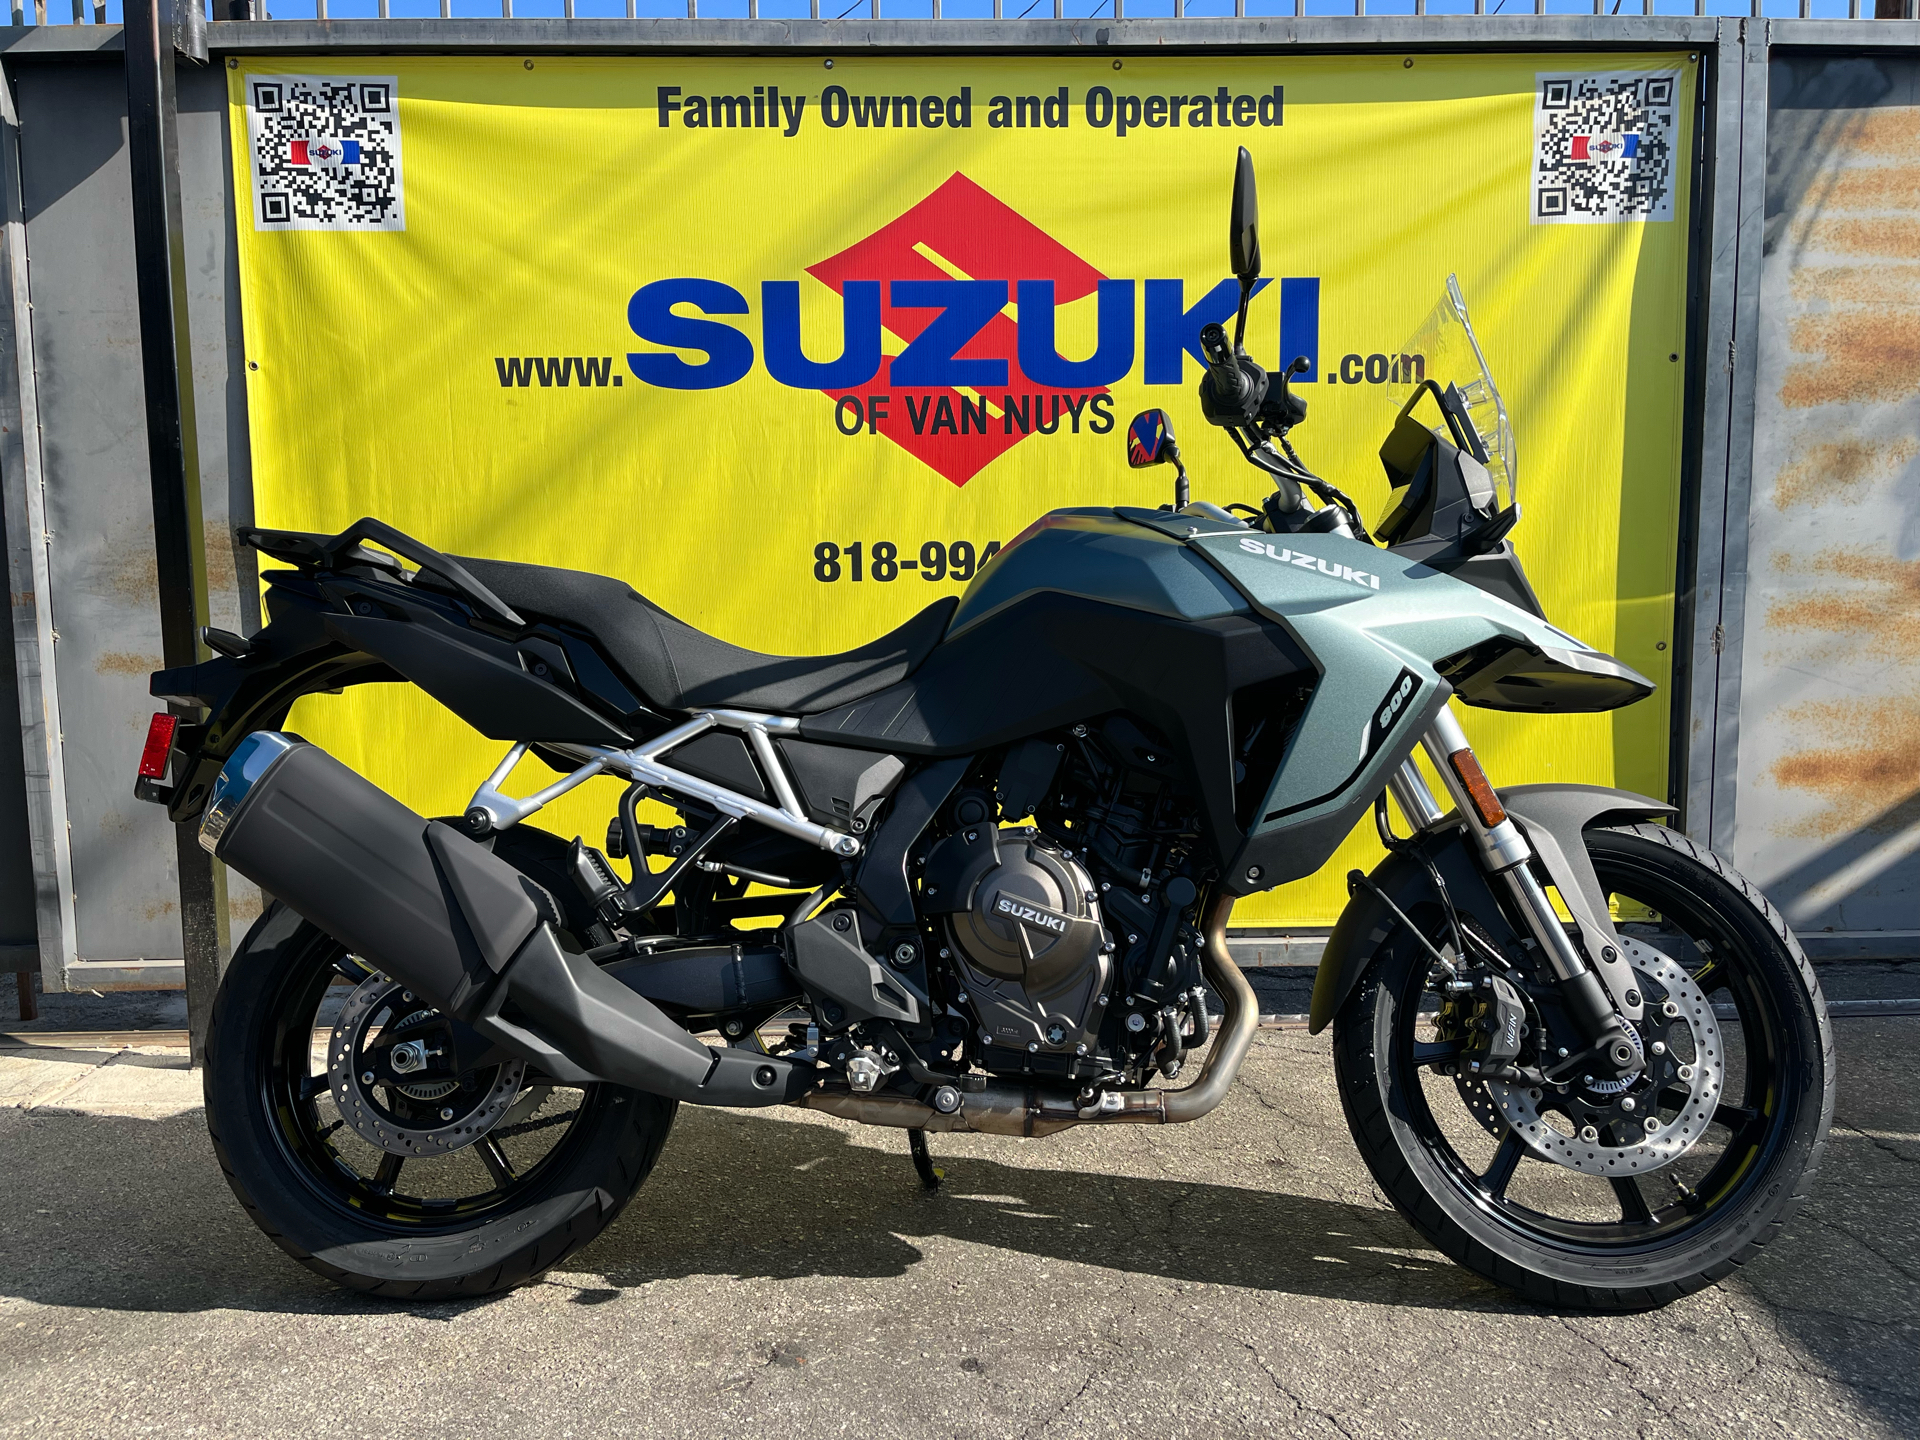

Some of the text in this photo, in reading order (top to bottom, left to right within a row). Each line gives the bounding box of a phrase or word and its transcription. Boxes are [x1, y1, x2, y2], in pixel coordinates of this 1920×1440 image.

[657, 85, 1284, 137] Family Owned and Operated
[835, 394, 1115, 435] OF VAN NUYS
[1239, 538, 1380, 590] SUZUKI
[1379, 675, 1413, 729] 800
[998, 899, 1066, 932] SUZUKI
[1505, 1013, 1517, 1048] NISSIN
